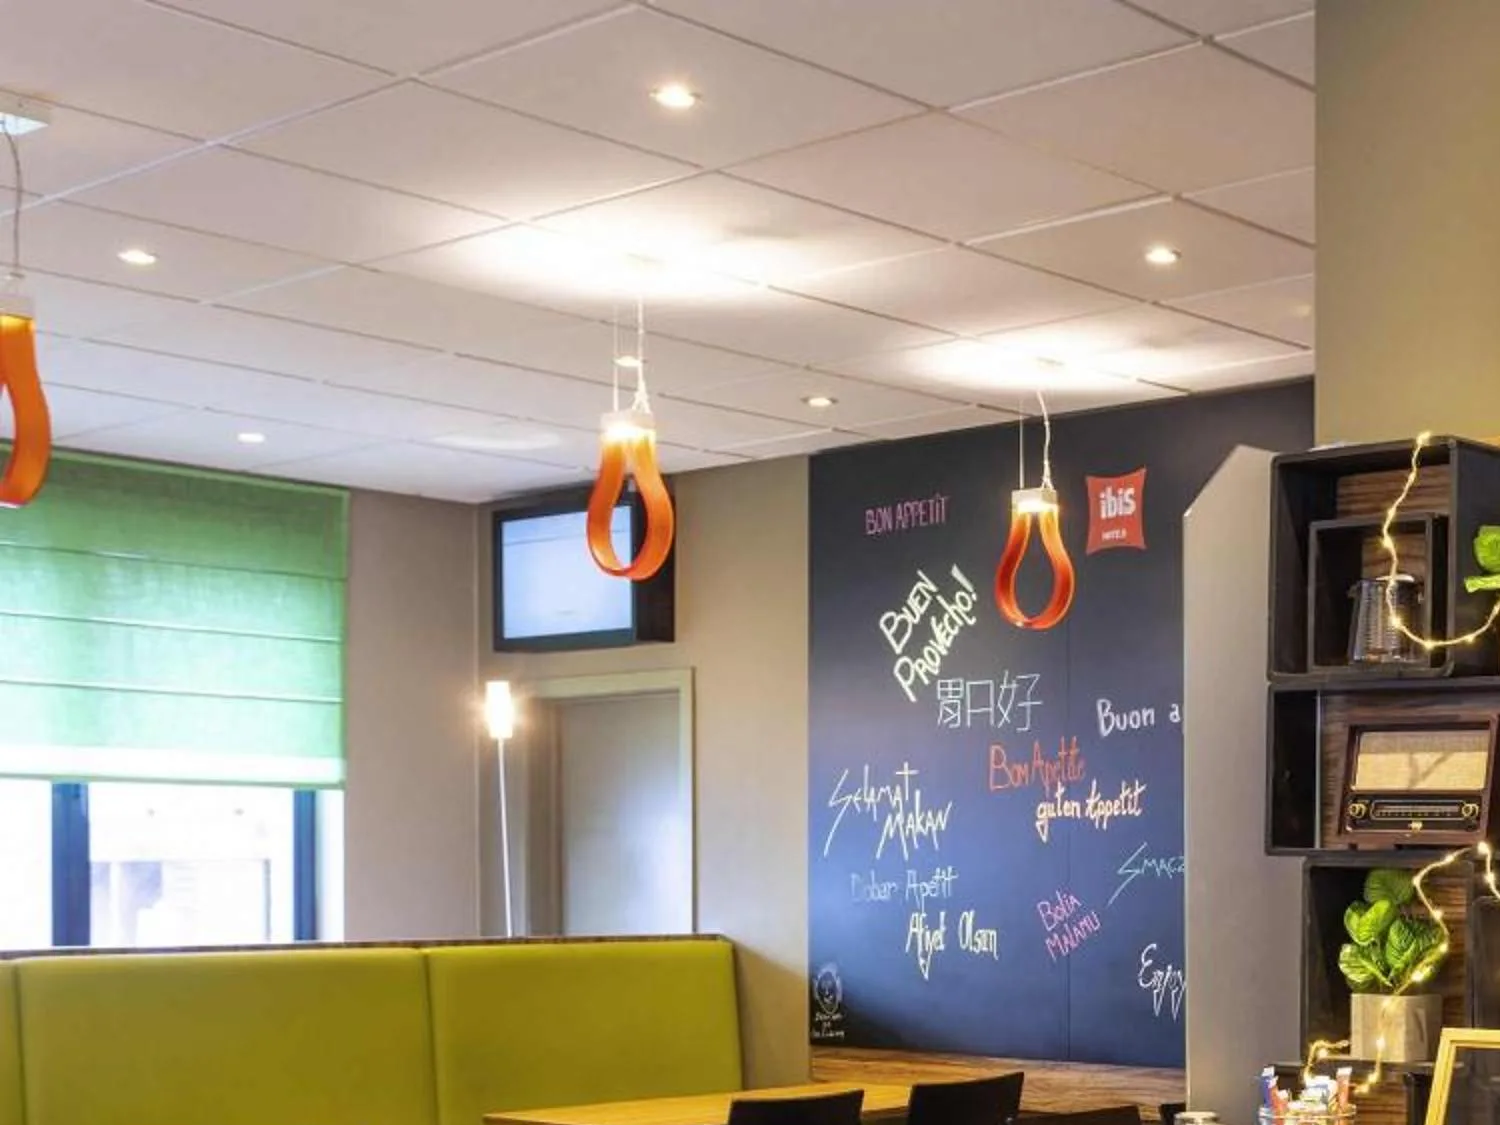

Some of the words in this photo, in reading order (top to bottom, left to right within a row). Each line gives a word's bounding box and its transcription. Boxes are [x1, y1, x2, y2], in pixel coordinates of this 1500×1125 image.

[1099, 486, 1136, 520] ibis
[865, 506, 893, 535] BON
[1096, 699, 1155, 737] Buon
